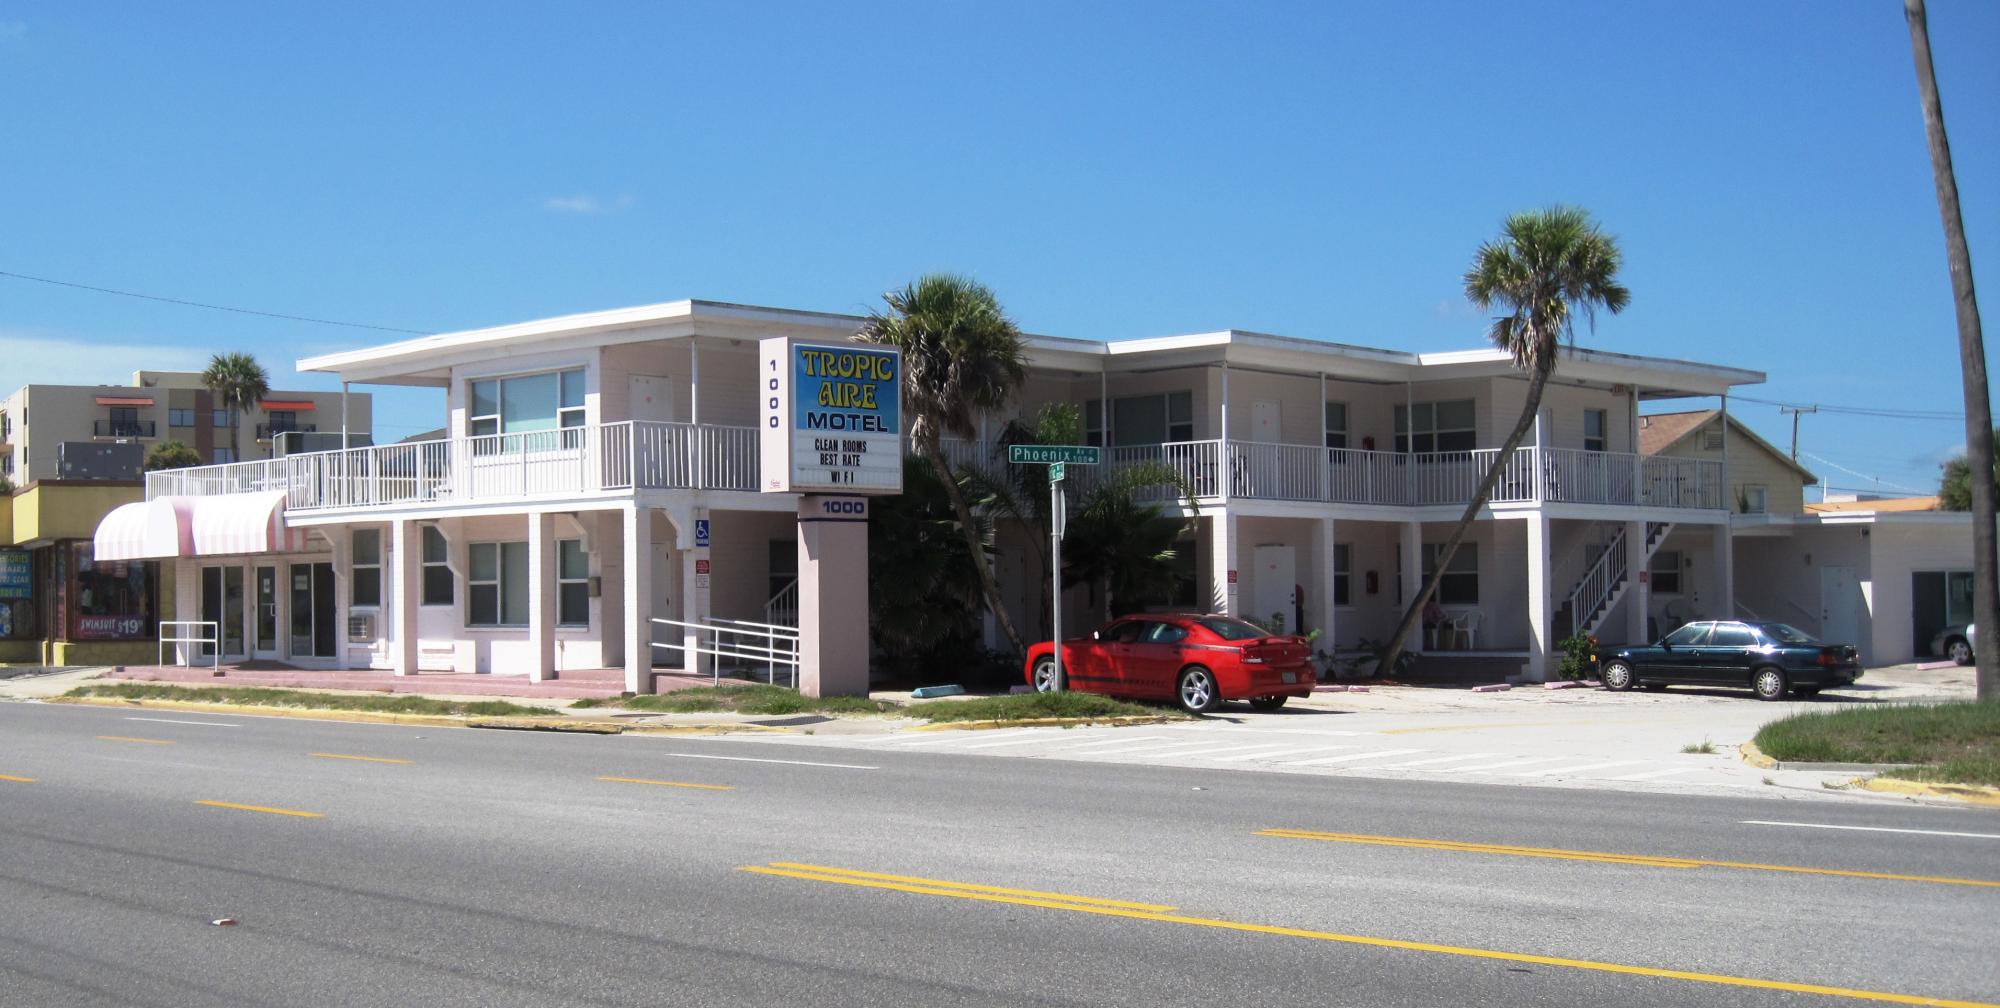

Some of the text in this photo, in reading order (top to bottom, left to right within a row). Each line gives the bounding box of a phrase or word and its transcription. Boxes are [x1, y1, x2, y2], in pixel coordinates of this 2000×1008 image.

[801, 350, 893, 382] TROPIC
[769, 359, 779, 429] 1000
[818, 381, 878, 409] AIRE
[807, 411, 888, 432] MOTEL
[814, 438, 867, 453] CLEAN ROOMS
[820, 453, 860, 467] BEST RATE
[1014, 447, 1070, 461] Phoenix
[822, 500, 865, 514] 1000
[80, 618, 116, 631] SWIMSUIT
